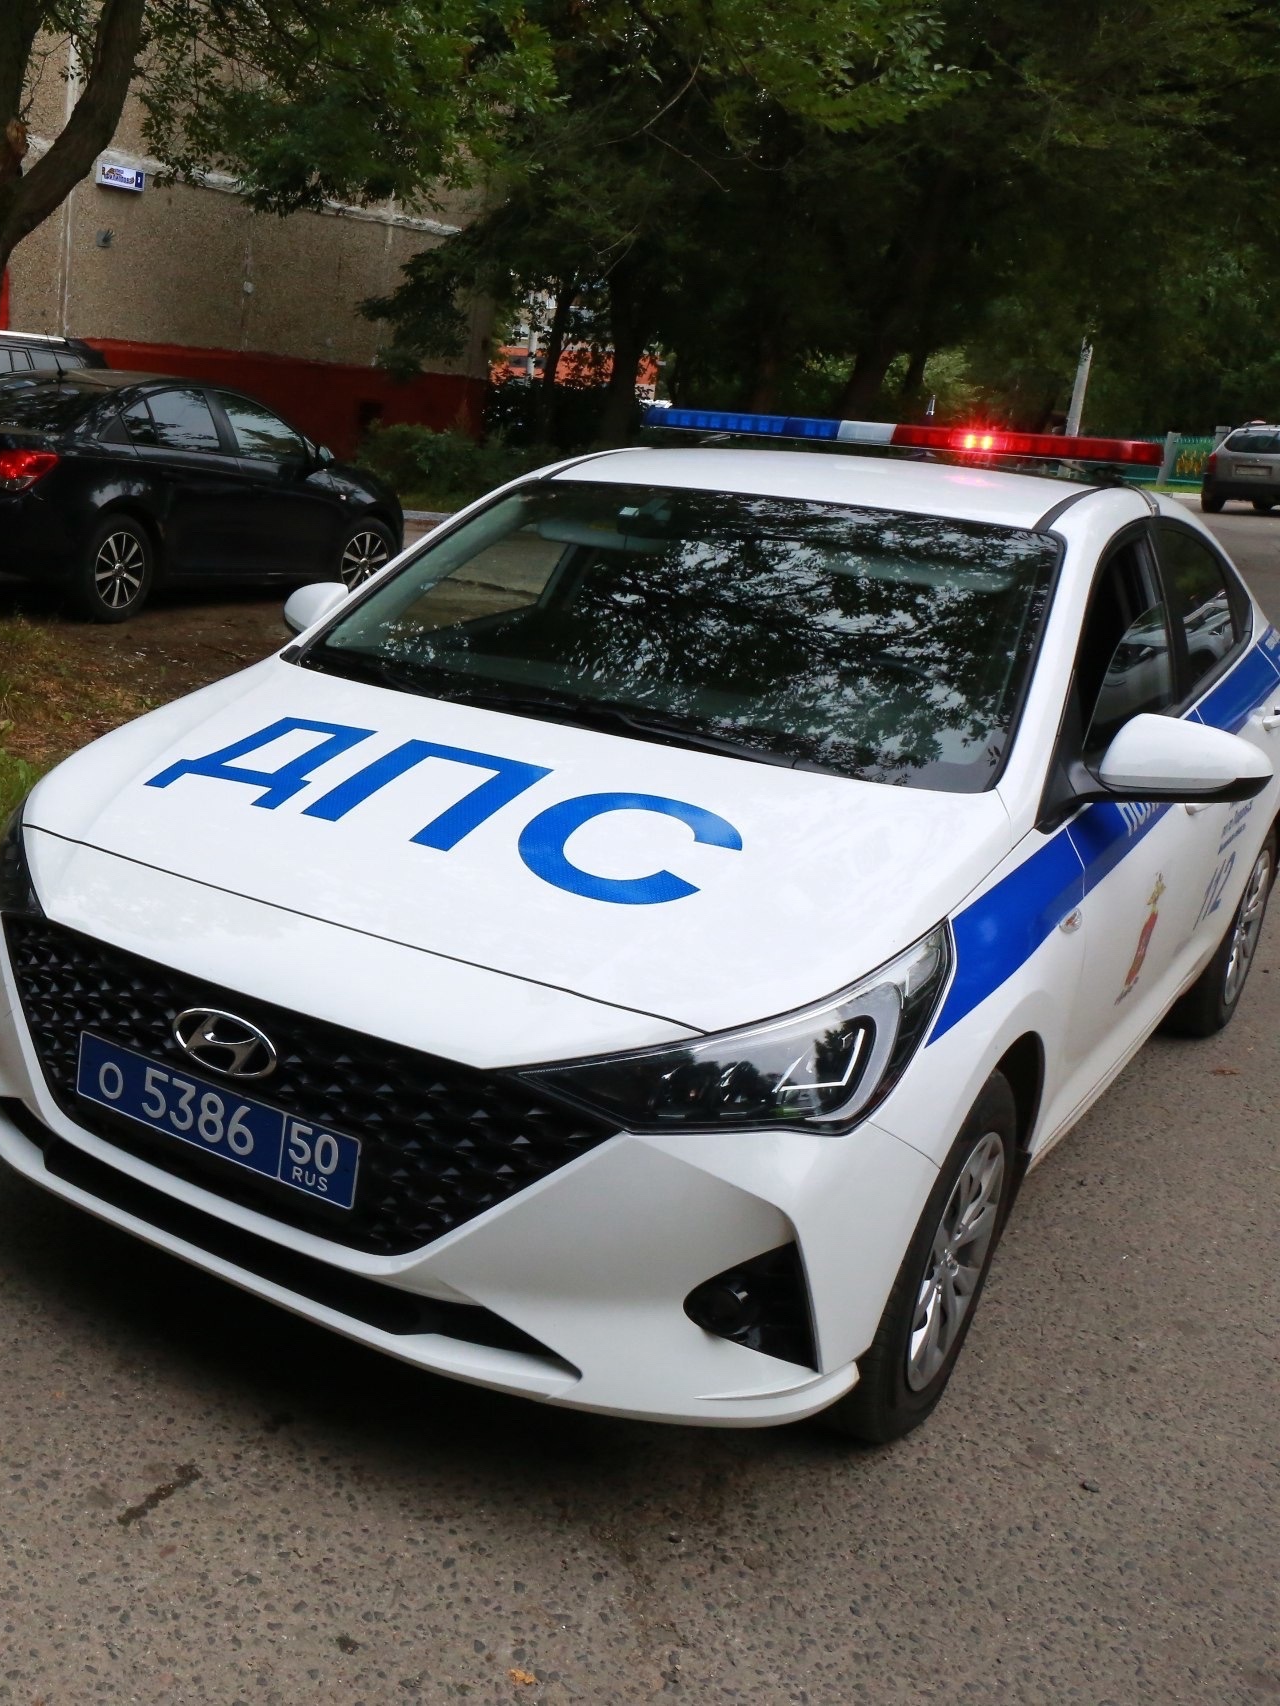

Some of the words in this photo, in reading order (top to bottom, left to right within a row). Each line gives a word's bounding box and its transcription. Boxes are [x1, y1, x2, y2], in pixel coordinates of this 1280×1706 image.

[143, 716, 744, 905] ДПС
[98, 1061, 124, 1100] О
[141, 1066, 255, 1156] 5386
[287, 1121, 339, 1175] 50
[291, 1167, 328, 1193] RUS
